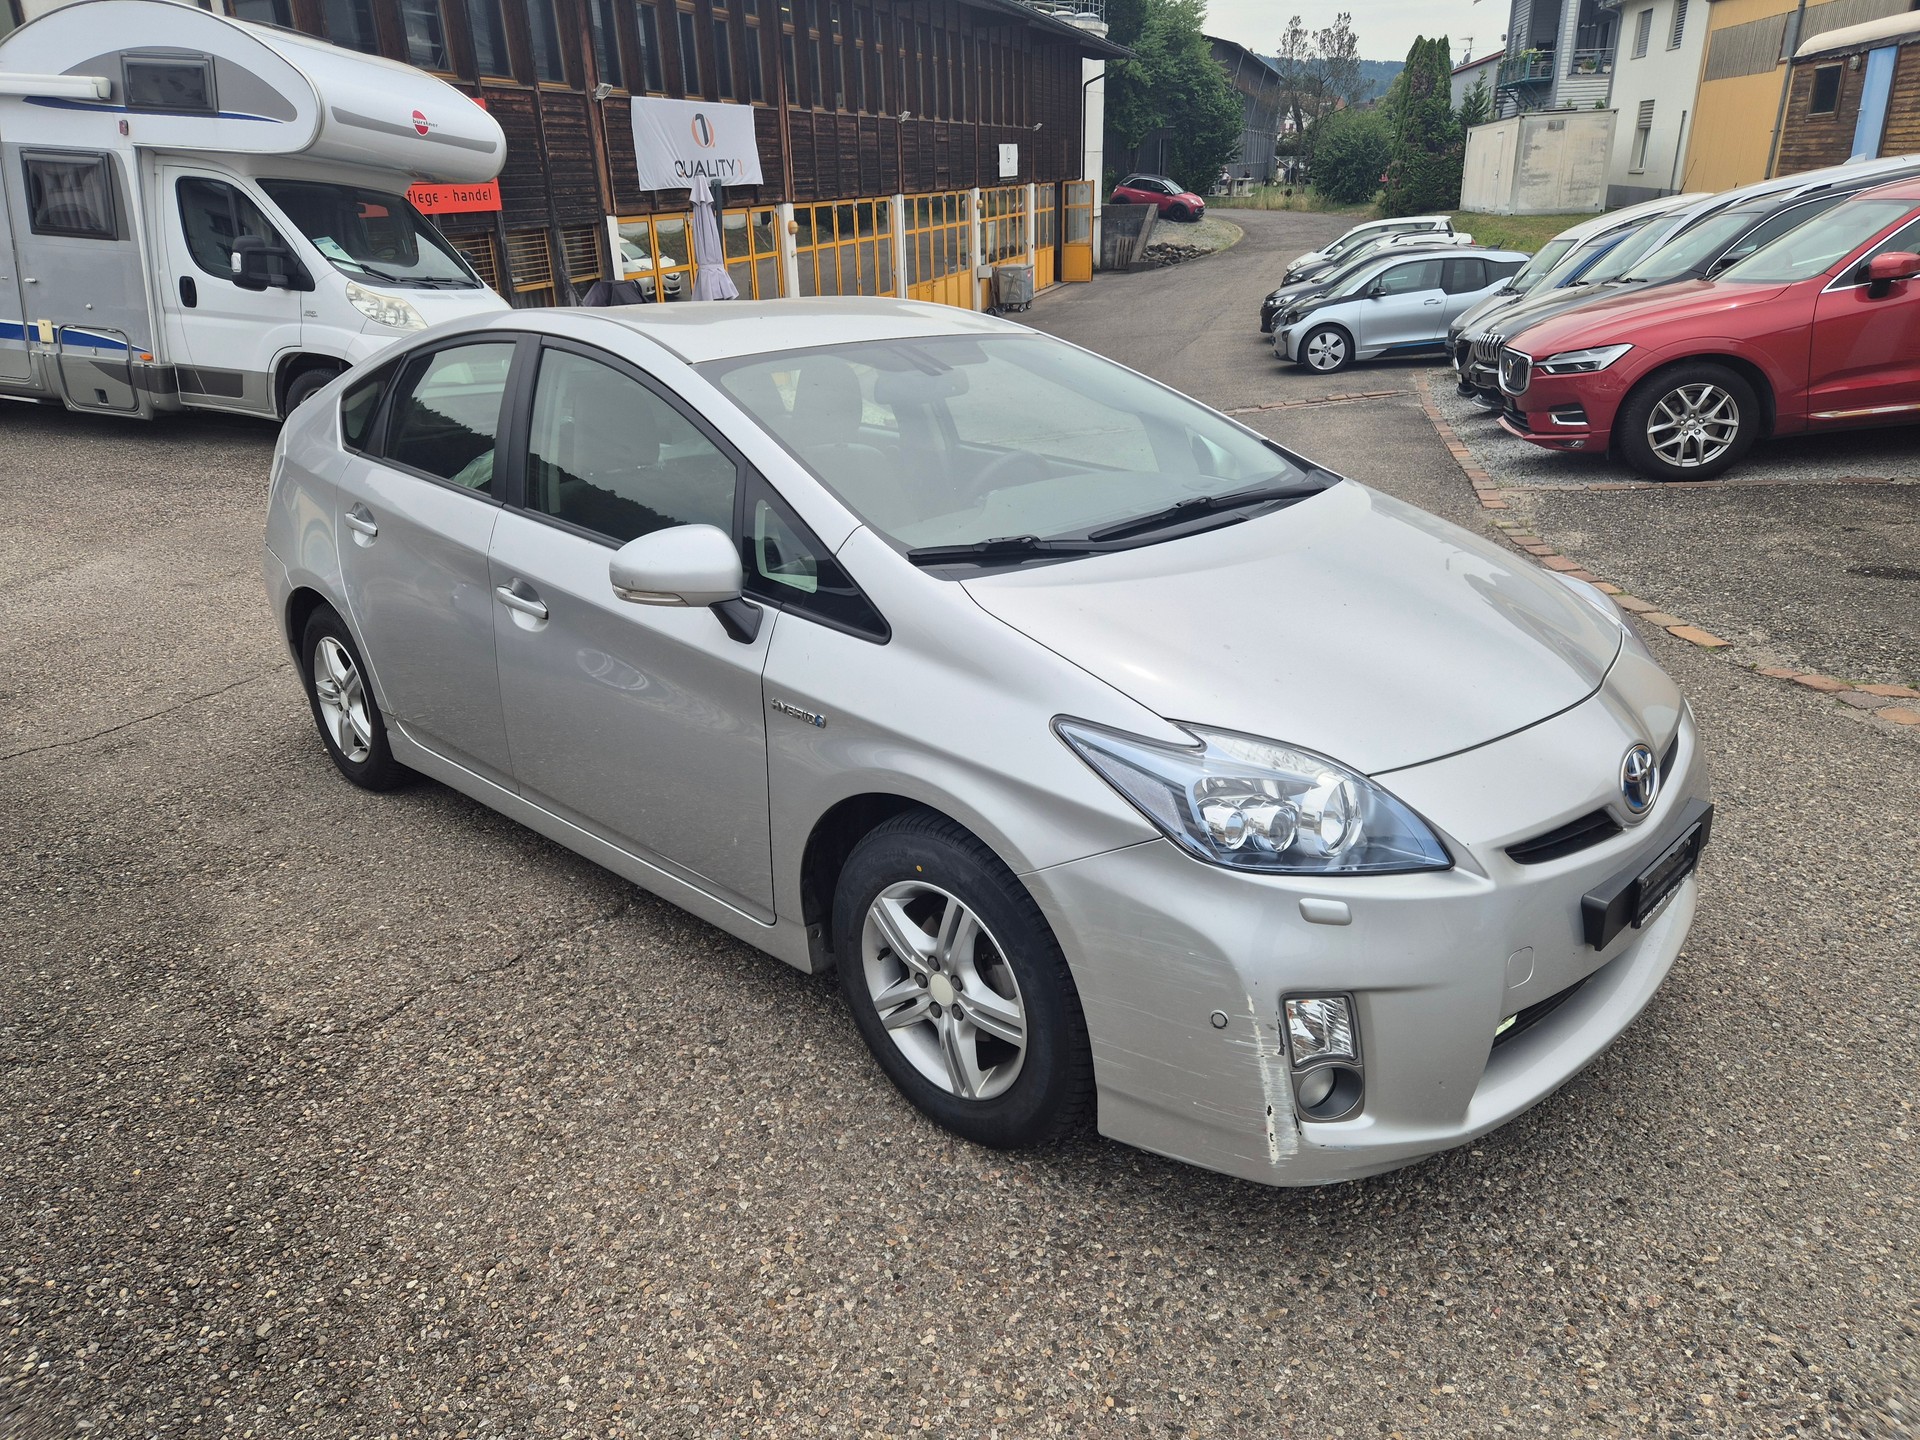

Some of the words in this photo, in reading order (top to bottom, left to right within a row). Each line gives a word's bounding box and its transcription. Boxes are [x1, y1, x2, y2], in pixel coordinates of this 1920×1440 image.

[674, 159, 735, 178] QUALITY
[452, 188, 492, 202] handel
[771, 698, 816, 725] HYBRID
